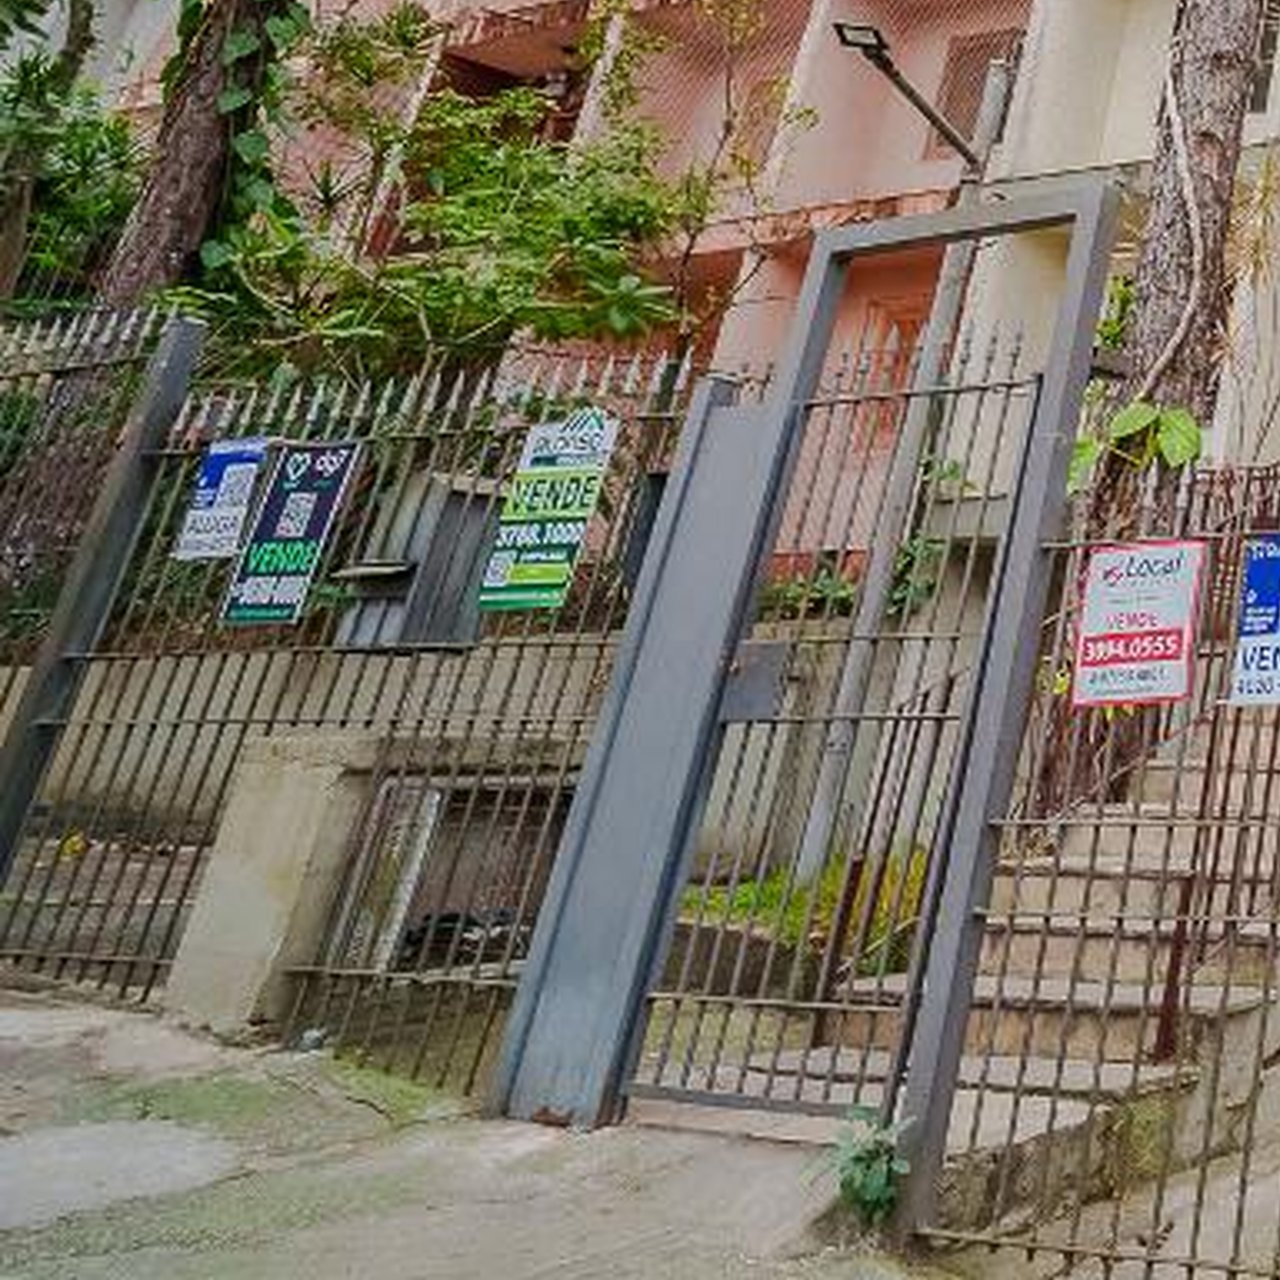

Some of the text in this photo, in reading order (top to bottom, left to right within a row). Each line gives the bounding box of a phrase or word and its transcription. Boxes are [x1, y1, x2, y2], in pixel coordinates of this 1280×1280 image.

[513, 475, 598, 512] VENDE
[248, 540, 318, 573] VENDE
[1105, 612, 1159, 630] VENDE
